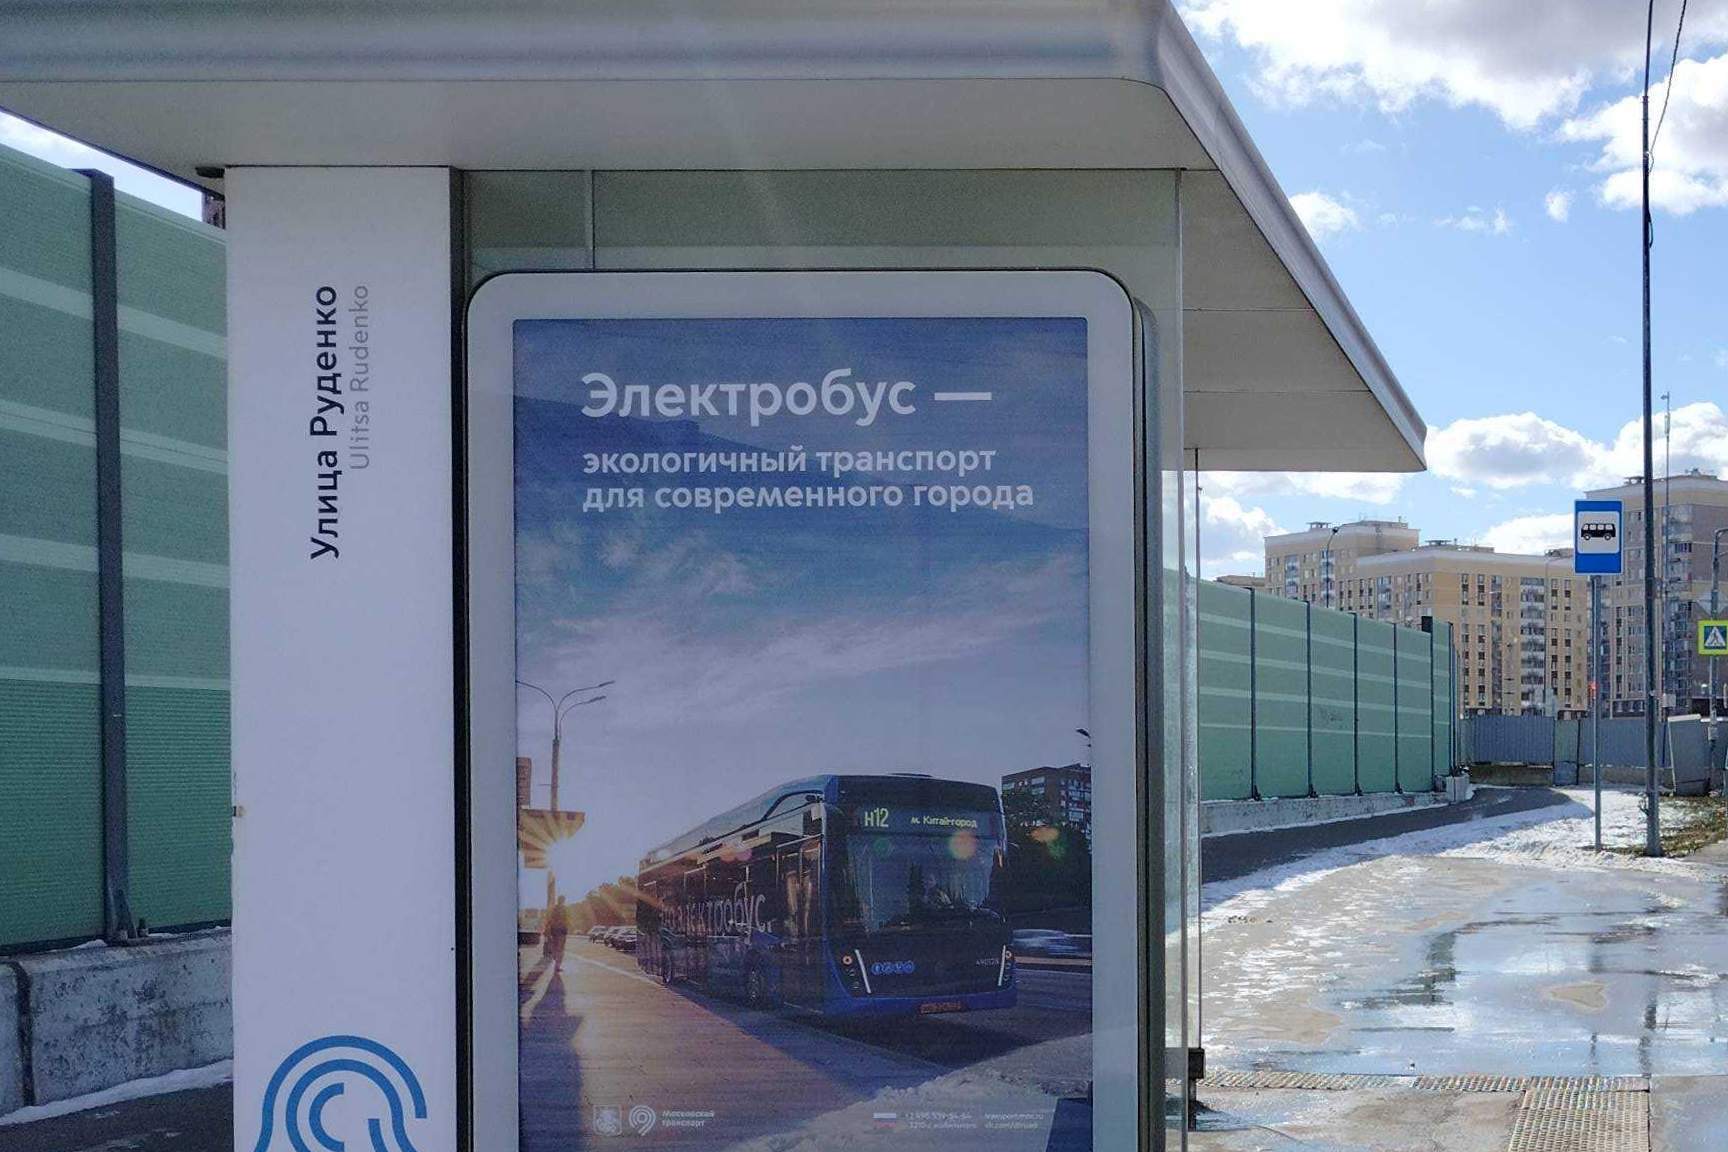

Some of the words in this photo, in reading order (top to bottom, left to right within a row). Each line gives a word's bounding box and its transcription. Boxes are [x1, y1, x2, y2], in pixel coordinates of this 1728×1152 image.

[309, 285, 345, 437] Руденко
[348, 285, 369, 393] Rudenko
[580, 367, 917, 428] Электробус
[349, 400, 370, 470] Ulitsa
[583, 444, 807, 474] экологичный
[815, 450, 996, 478] транспорт
[310, 450, 343, 560] Улица
[582, 487, 645, 513] для
[654, 486, 904, 514] современного
[913, 484, 1034, 513] города
[923, 815, 978, 829] Китай-город
